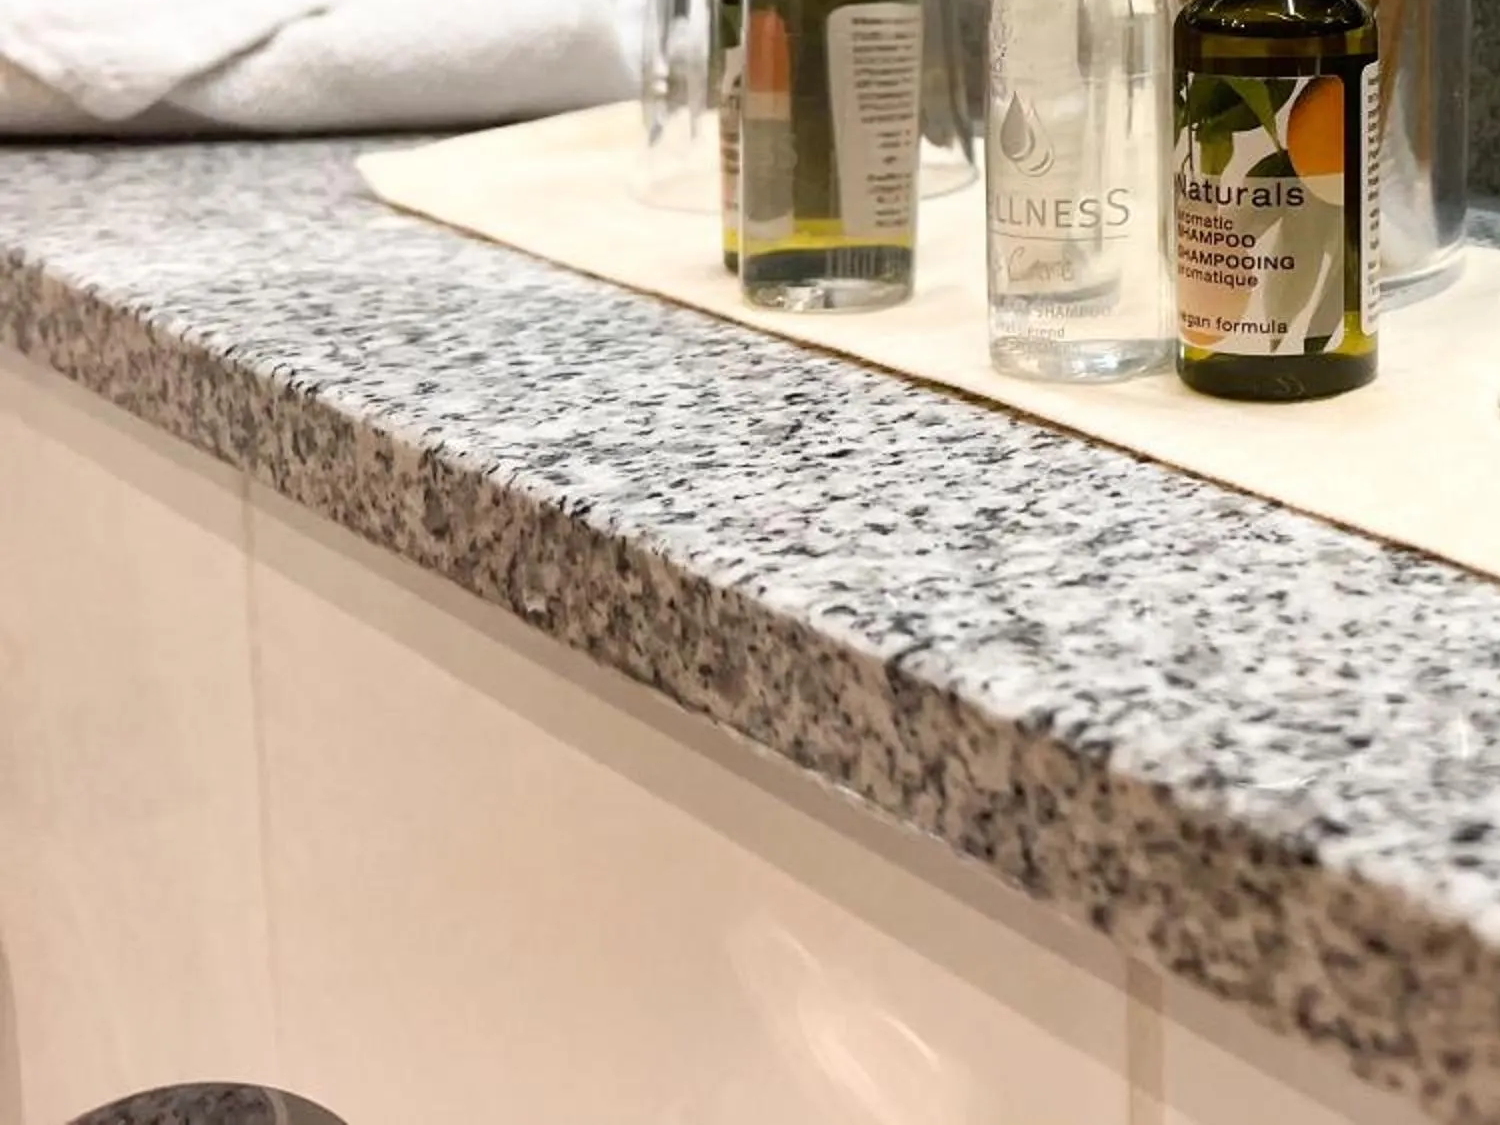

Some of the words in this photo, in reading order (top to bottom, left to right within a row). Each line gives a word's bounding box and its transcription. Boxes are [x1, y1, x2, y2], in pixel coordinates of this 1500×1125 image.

[1175, 173, 1305, 207] Naturals
[994, 188, 1130, 228] LLNESS
[1181, 312, 1211, 328] egan
[1216, 317, 1288, 334] formula
